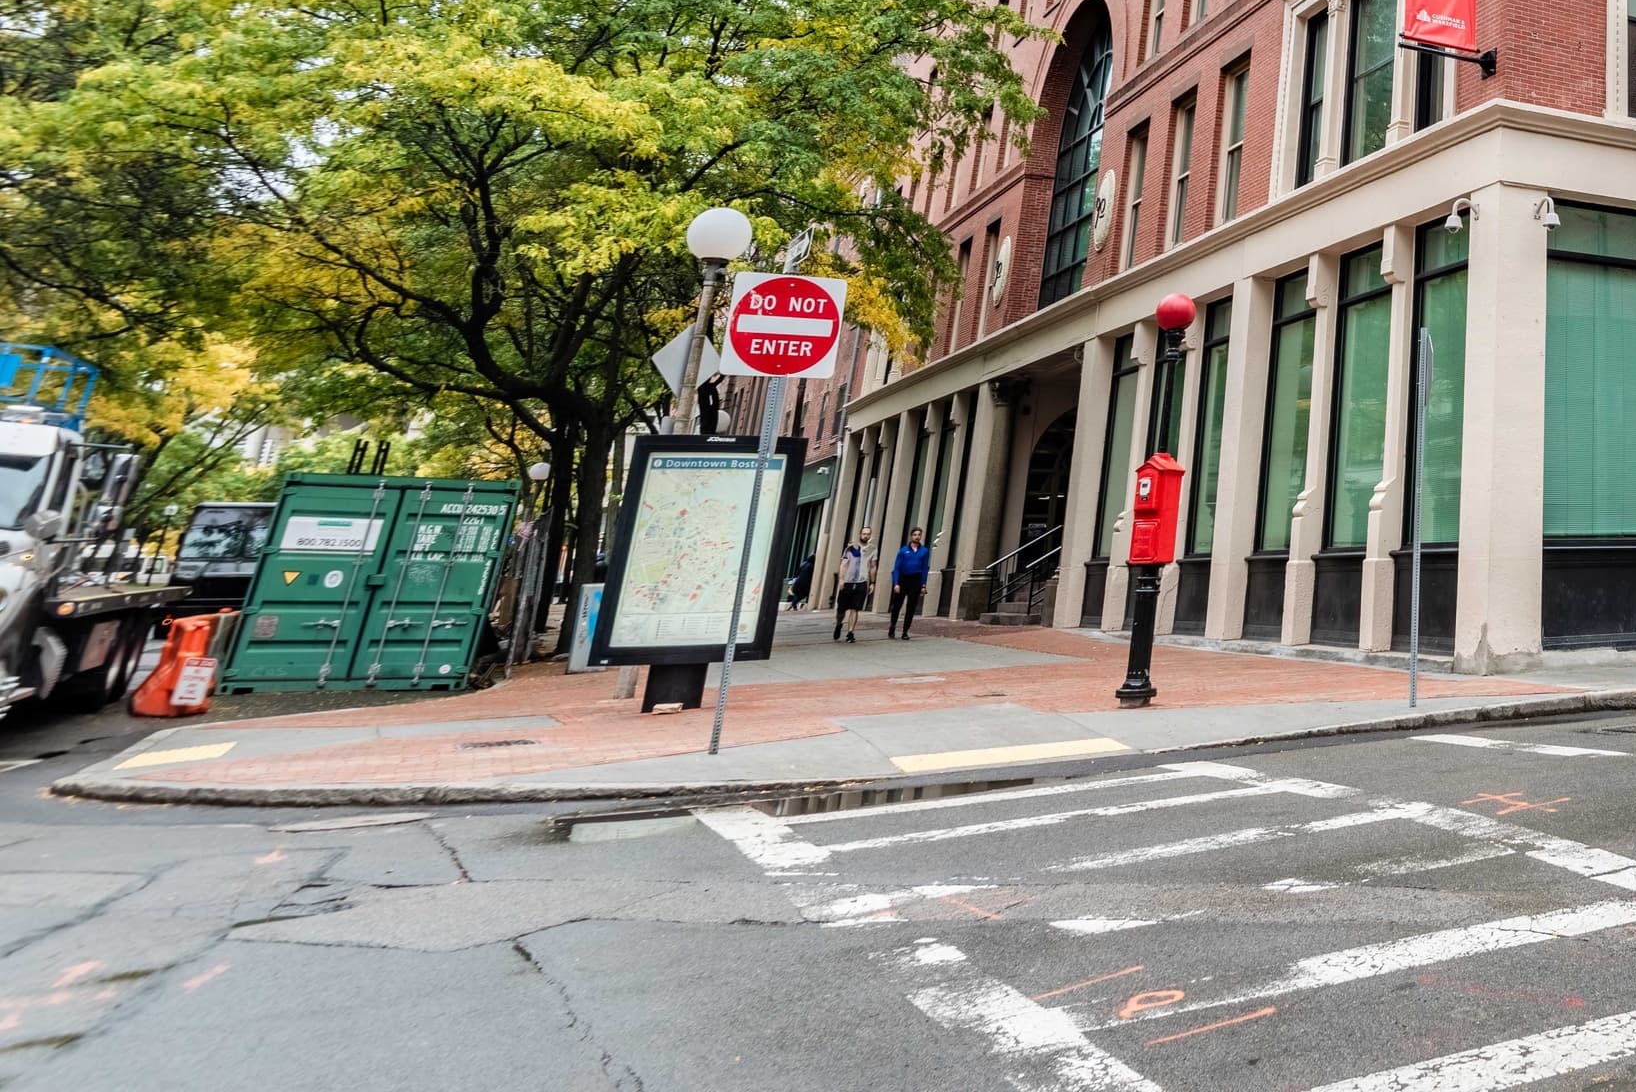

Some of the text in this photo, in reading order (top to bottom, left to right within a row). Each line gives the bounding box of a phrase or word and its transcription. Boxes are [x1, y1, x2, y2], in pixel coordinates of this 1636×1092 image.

[750, 294, 828, 314] DO NOT
[750, 339, 813, 357] ENTER
[665, 459, 727, 468] Downtown
